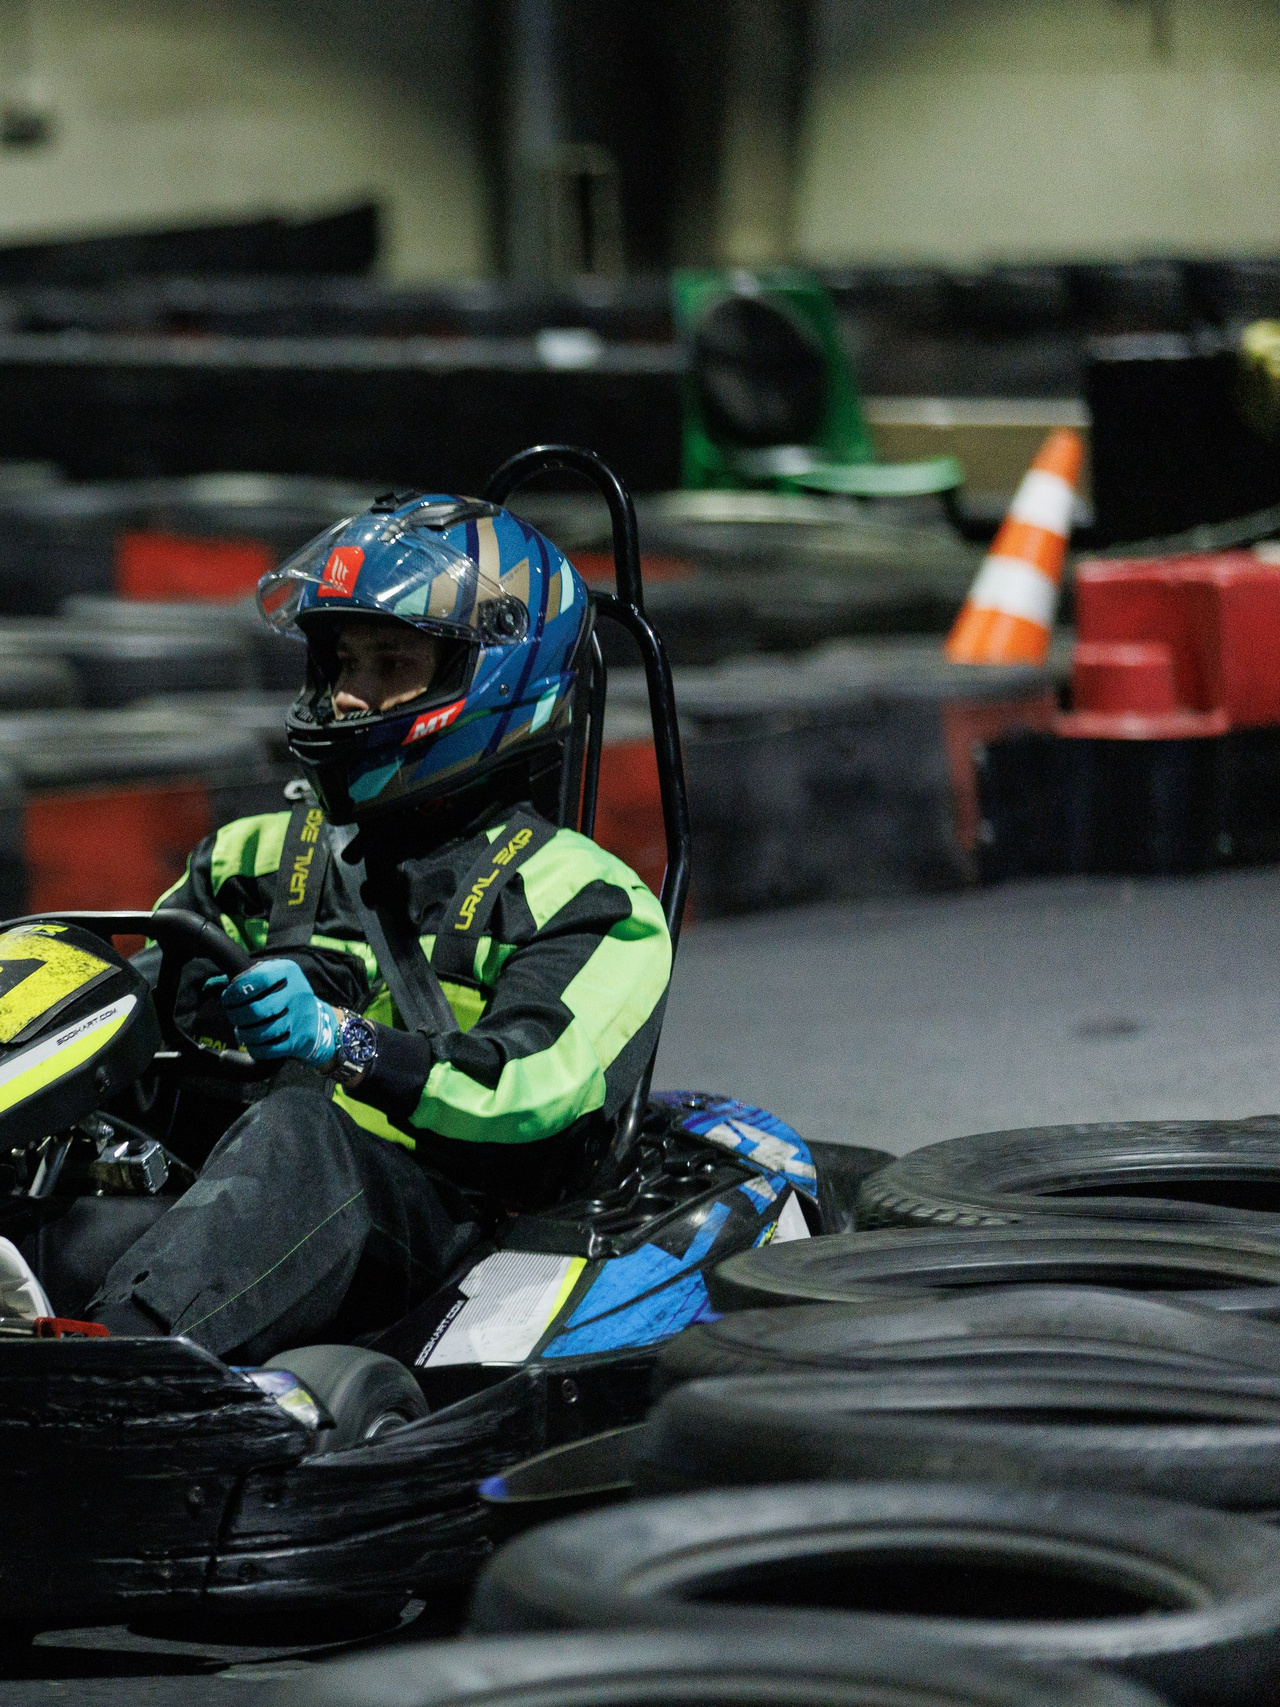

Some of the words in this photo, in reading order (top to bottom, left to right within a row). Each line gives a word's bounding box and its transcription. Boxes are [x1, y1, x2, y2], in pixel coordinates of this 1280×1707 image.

[412, 706, 458, 739] MT
[287, 846, 315, 906] URAL
[454, 868, 500, 930] URAL
